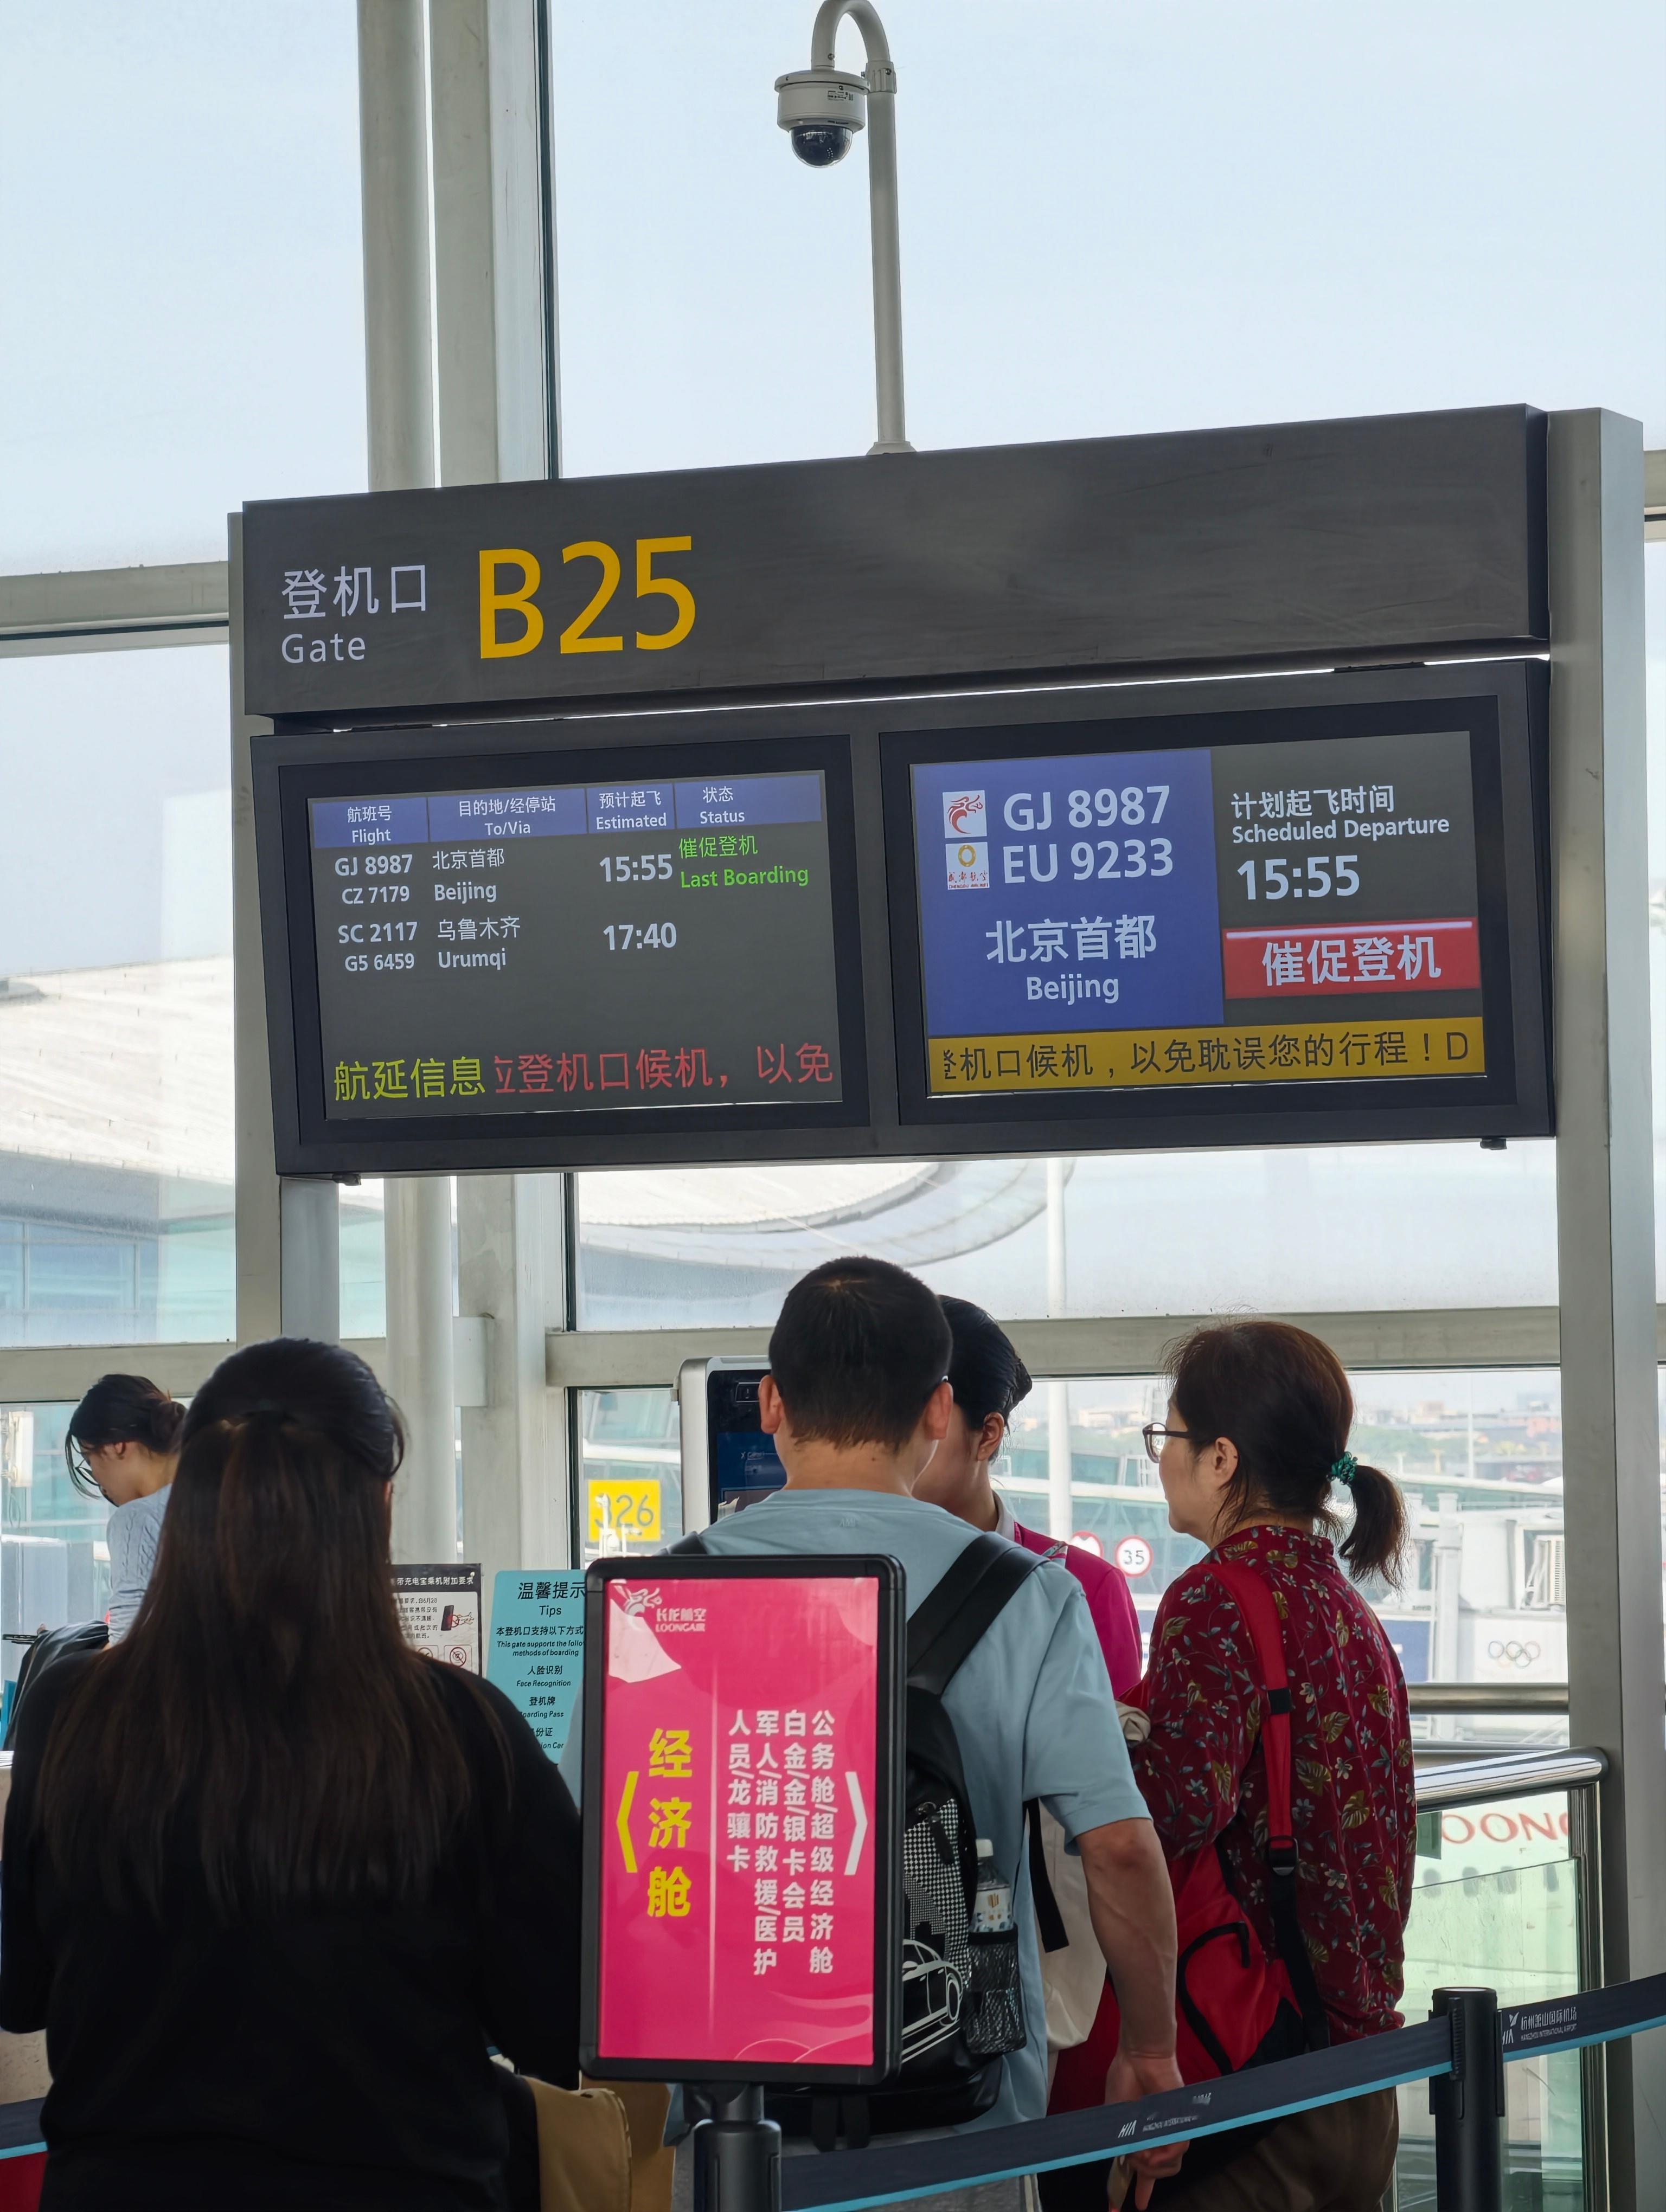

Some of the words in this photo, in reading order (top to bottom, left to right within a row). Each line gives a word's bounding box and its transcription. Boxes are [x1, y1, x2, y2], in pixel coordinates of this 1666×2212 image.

[281, 564, 427, 620] 登机口
[479, 536, 696, 660] B25
[281, 633, 366, 664] Gate
[599, 790, 662, 809] 预计起飞
[702, 786, 734, 803] 状态
[1231, 785, 1395, 820] 计划起飞时间
[347, 805, 392, 823] 航班号
[459, 796, 556, 817] 目的地/经停站
[700, 810, 745, 825] Status
[1003, 792, 1053, 831] GJ
[1068, 785, 1170, 828] 8987
[484, 820, 531, 837] To/Via
[596, 812, 667, 830] Estimated
[1232, 819, 1337, 844] Scheduled
[1343, 816, 1450, 841] Departure
[351, 828, 391, 845] Flight
[678, 834, 759, 859] 催促登机
[334, 857, 358, 877] GJ
[365, 854, 413, 875] 8987
[432, 847, 505, 871] 北京首都
[599, 853, 674, 882] 15:55
[1003, 844, 1058, 884] EU
[1070, 838, 1174, 881] 9233
[680, 870, 719, 889] Last
[723, 865, 809, 886] Boarding
[1236, 854, 1360, 901] 15:55
[341, 888, 364, 904] CZ
[368, 885, 410, 903] 7179
[434, 881, 497, 904] Beijing
[338, 924, 364, 944] SC
[370, 921, 418, 943] 2117
[437, 915, 521, 941] 乌鲁木齐
[603, 922, 677, 951] 17:40
[985, 914, 1157, 964] 北京首都
[345, 955, 369, 972] G5
[373, 953, 415, 970] 6459
[438, 948, 507, 970] Urumqi
[1262, 935, 1441, 986] 催促登机
[1027, 973, 1119, 1006] Beijing
[333, 1055, 486, 1101] 航延信息
[1123, 1549, 1145, 1565] 35
[517, 1581, 586, 1600] 温馨提示
[539, 1605, 562, 1618] Tips
[527, 1665, 563, 1675] 人脸识别
[533, 1680, 572, 1688] Recognition
[529, 1696, 556, 1706] 登机牌
[521, 1711, 548, 1719] oarding
[531, 1727, 554, 1737] 份证
[647, 1728, 694, 1918] 经济舱
[1442, 1812, 1568, 1844] OON
